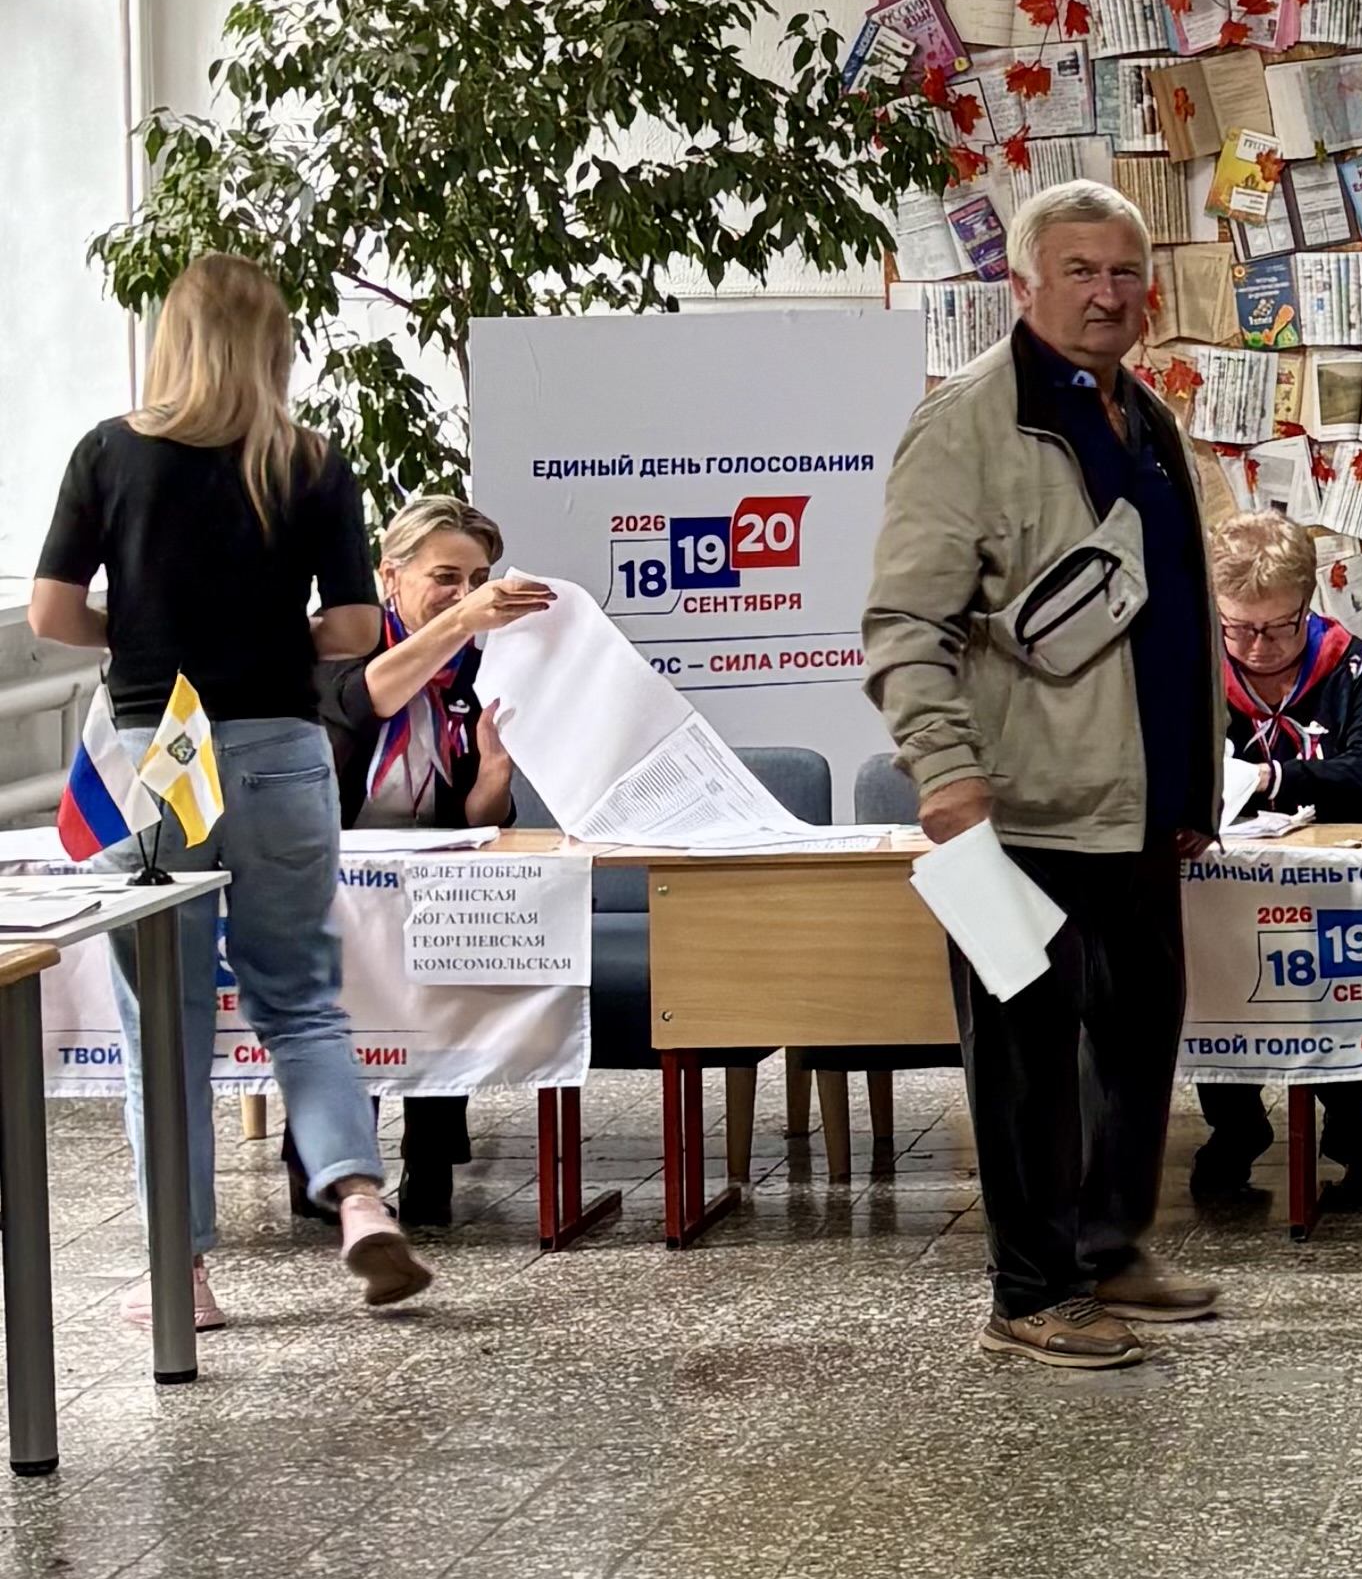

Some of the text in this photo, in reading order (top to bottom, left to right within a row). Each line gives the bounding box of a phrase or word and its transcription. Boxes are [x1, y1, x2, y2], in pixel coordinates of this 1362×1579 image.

[532, 454, 874, 480] ЕДИНЫЙ ДЕНЬ ГОЛОСОВАНИЯ
[611, 515, 666, 533] 2026
[736, 512, 795, 553] 20
[677, 533, 726, 575] 19
[618, 559, 668, 599] 18
[683, 592, 802, 614] СЕНТЯБРЯ
[710, 653, 773, 672] СИЛА
[411, 865, 542, 880] 30 ЛЕТ ПОБЕДЫ
[1280, 863, 1343, 886] ДЕНЬ
[412, 889, 517, 902] БАКИНСКАЯ
[1257, 906, 1312, 925] 2026
[412, 935, 545, 948] ГЕОРГИЕВСКАЯ
[413, 958, 571, 971] КОМСОМОЛЬСКАЯ
[1266, 949, 1317, 988] 18
[58, 1043, 122, 1064] ТВОЙ
[234, 1045, 272, 1063] СИ
[1185, 1032, 1248, 1056] ТВОЙ
[1255, 1036, 1334, 1057] ГОЛОС
[354, 1047, 408, 1065] СИИ!
